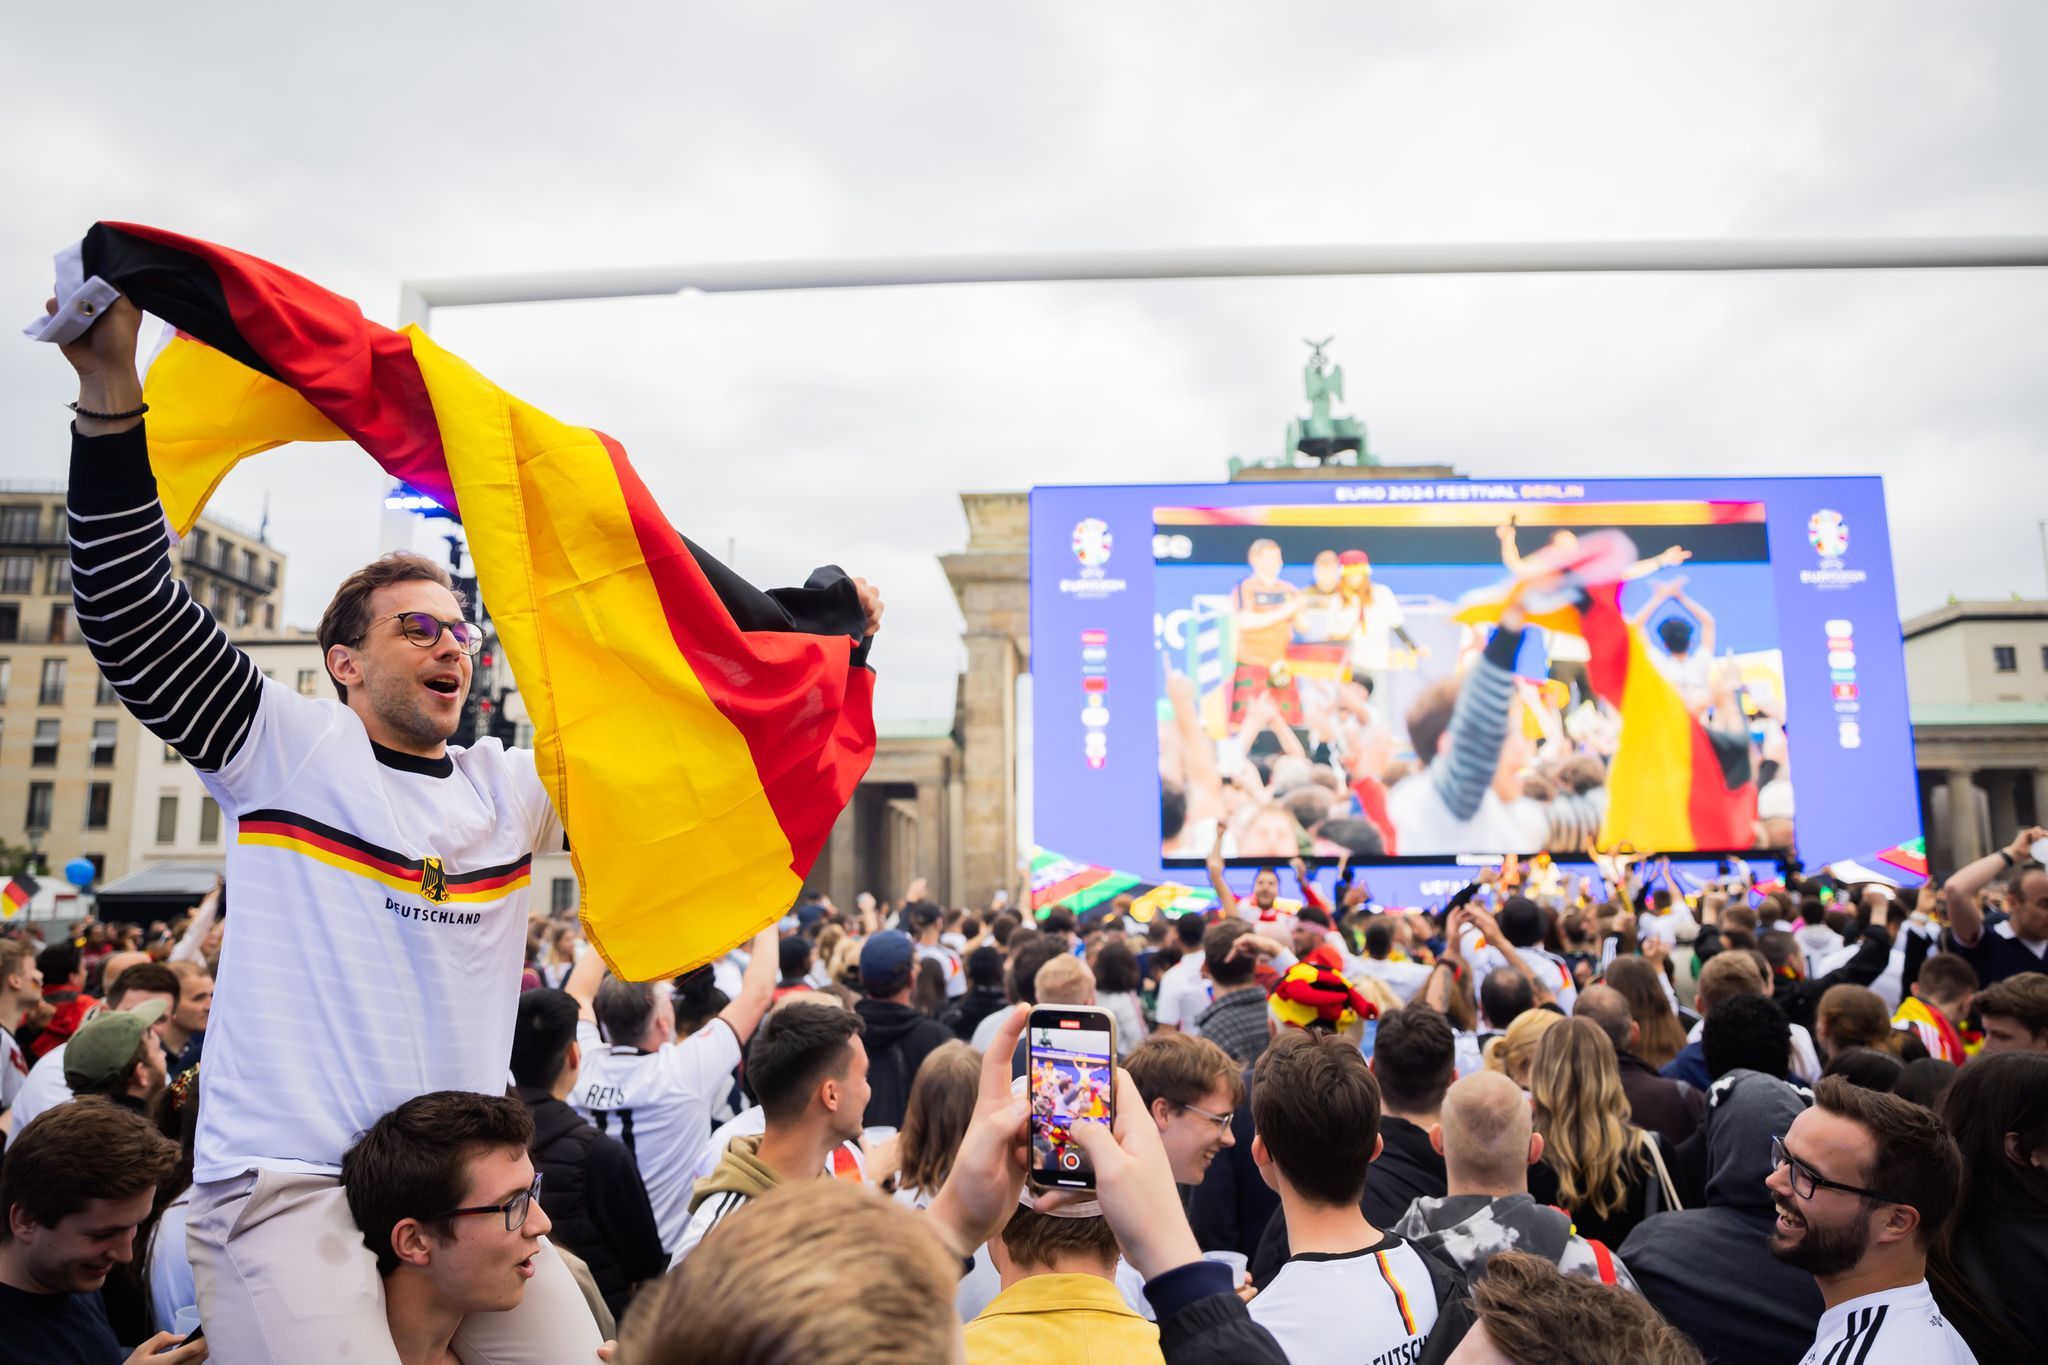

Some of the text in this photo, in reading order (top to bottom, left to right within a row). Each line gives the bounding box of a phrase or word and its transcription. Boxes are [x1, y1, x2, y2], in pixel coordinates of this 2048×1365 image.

[1335, 485, 1584, 501] EURO 2024 FESTIVAL BERLIN
[385, 897, 481, 925] DEUTSCHLAND
